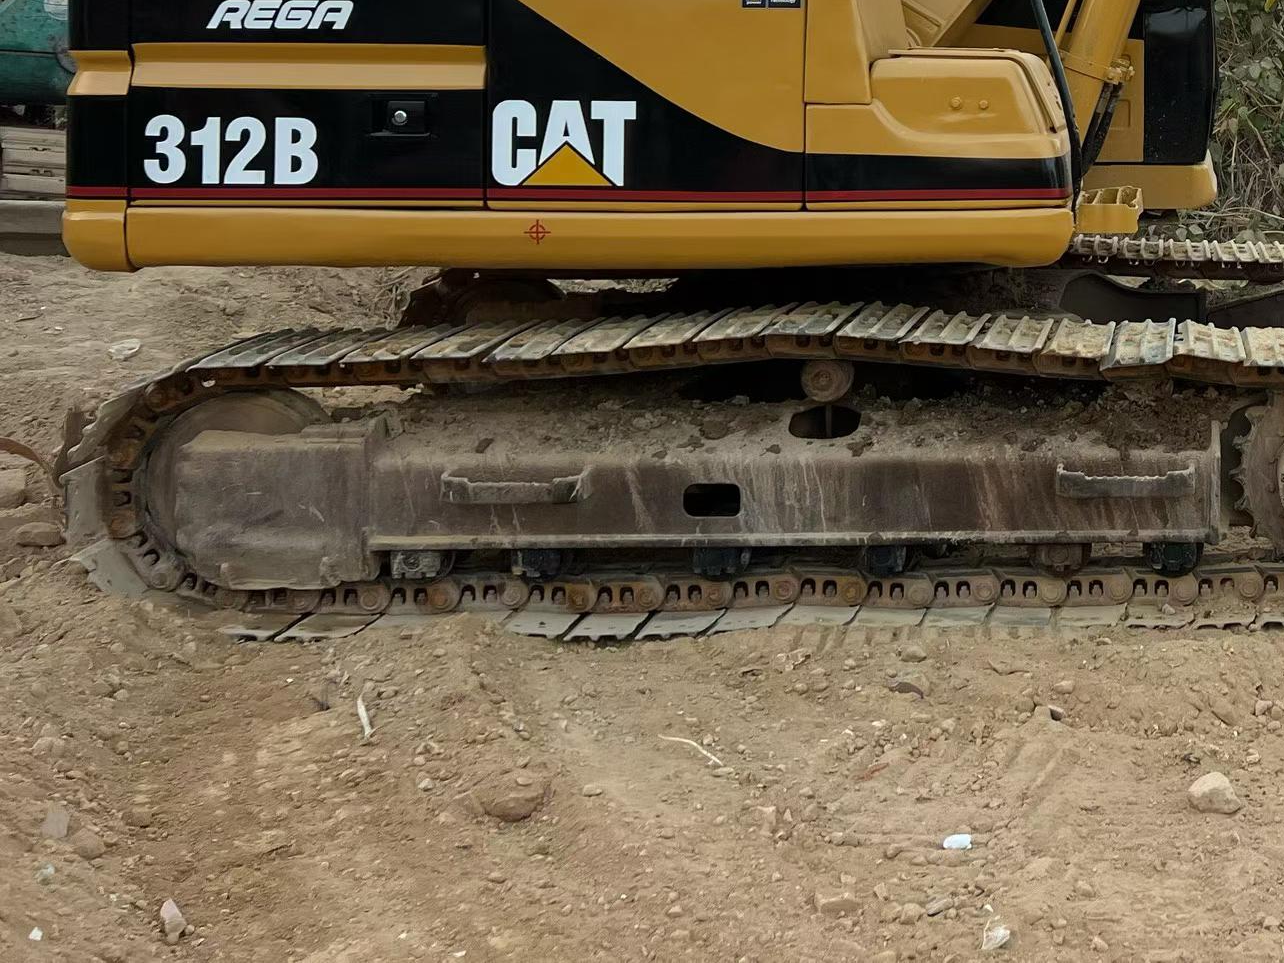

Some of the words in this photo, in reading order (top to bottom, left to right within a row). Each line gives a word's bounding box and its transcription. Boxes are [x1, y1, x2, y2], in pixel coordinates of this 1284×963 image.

[206, 0, 353, 30] REGA
[143, 114, 318, 185] 312B
[491, 100, 636, 187] CAT
